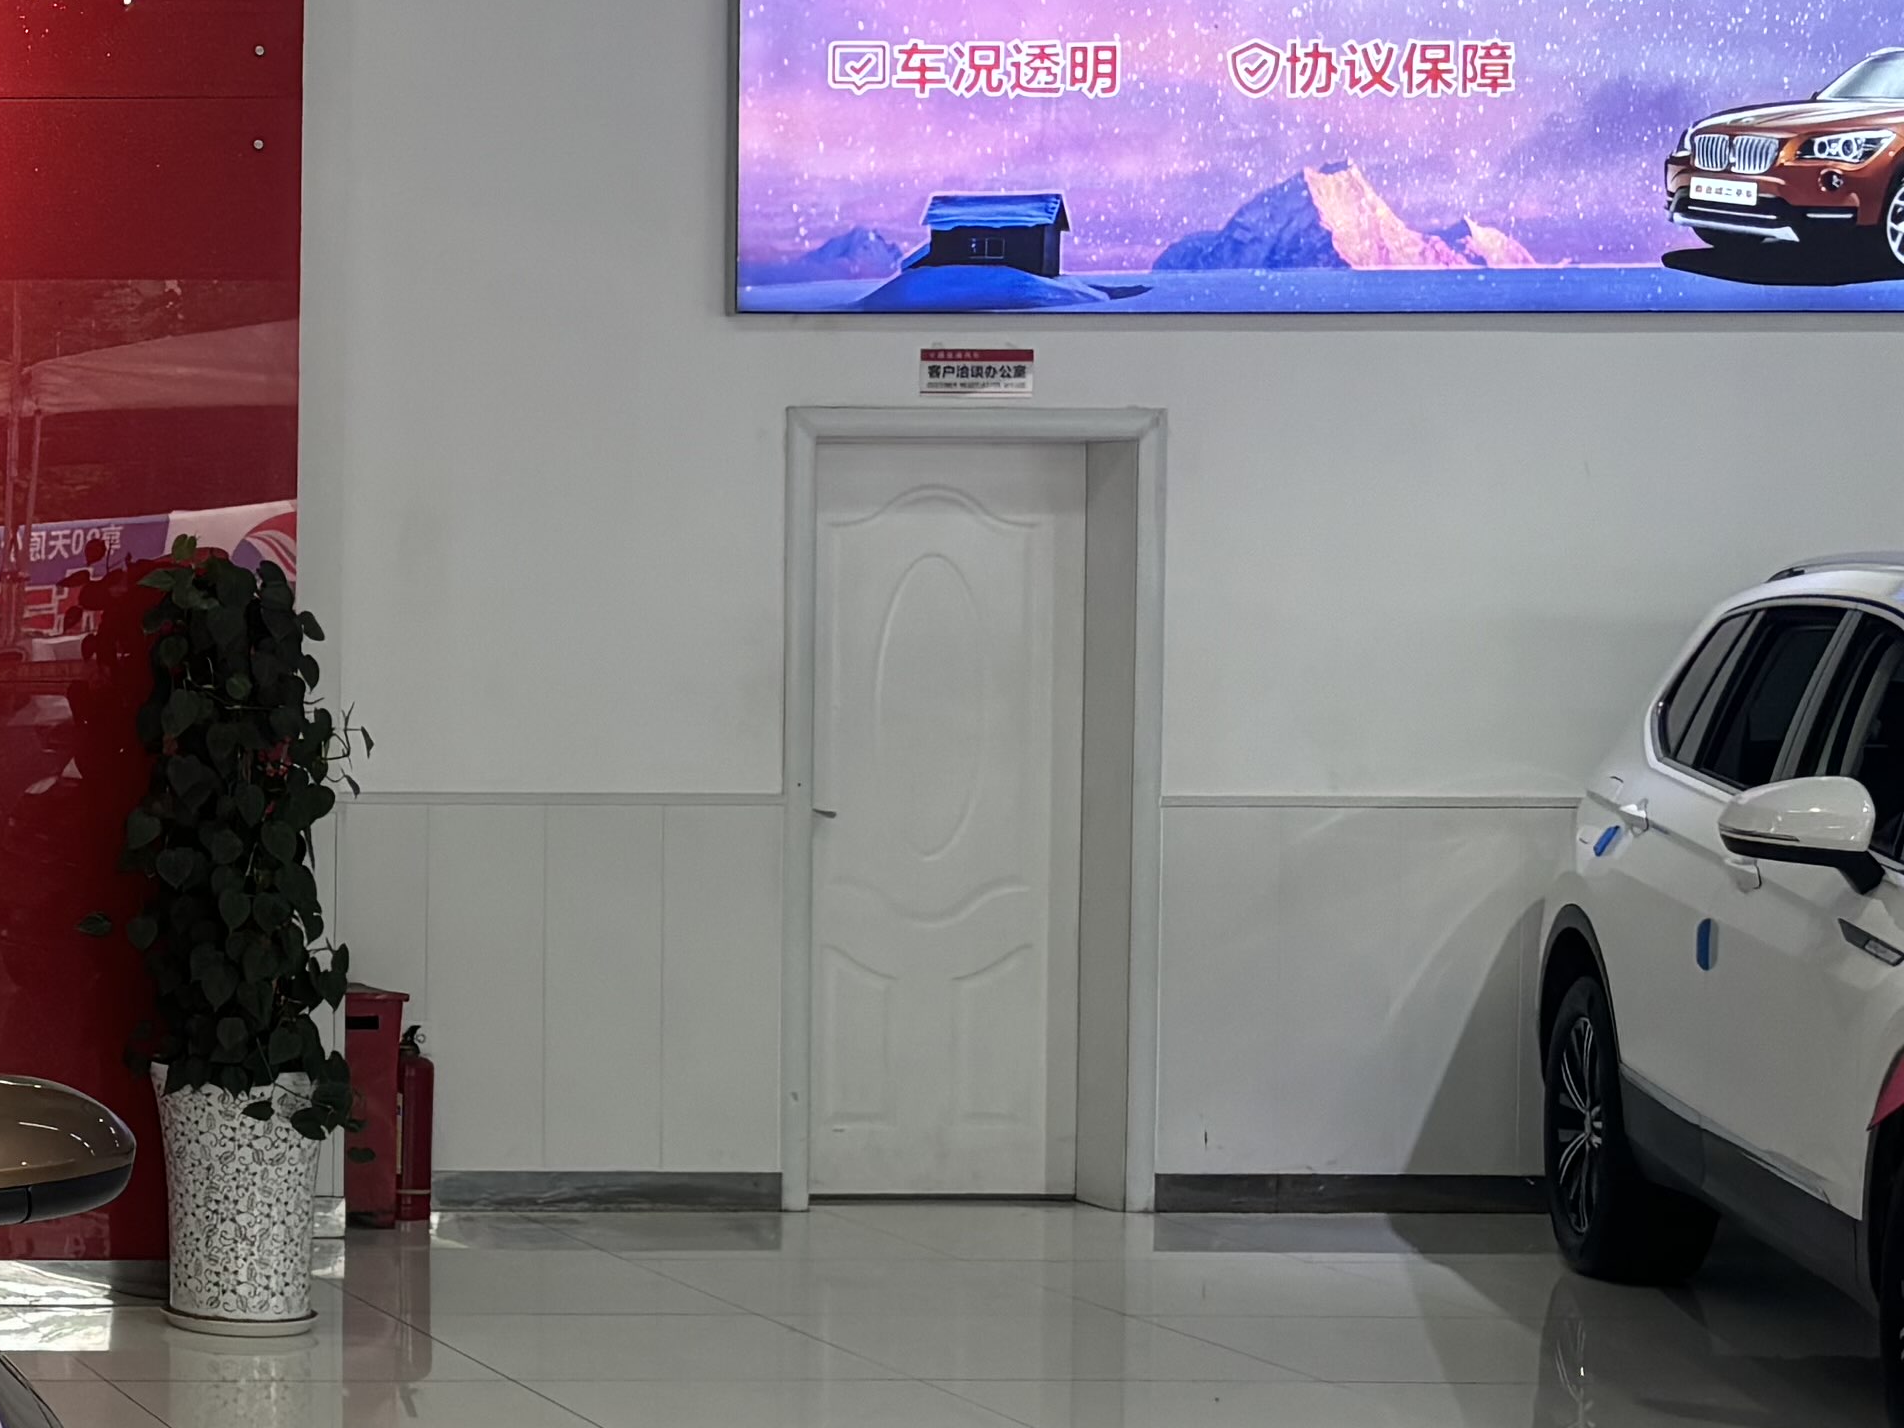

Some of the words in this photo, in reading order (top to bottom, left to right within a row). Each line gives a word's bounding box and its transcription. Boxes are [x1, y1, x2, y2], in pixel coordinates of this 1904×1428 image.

[892, 39, 1122, 98] 车况透明
[1284, 38, 1516, 98] 协议保障
[927, 365, 1027, 379] 客户洽谈办公室
